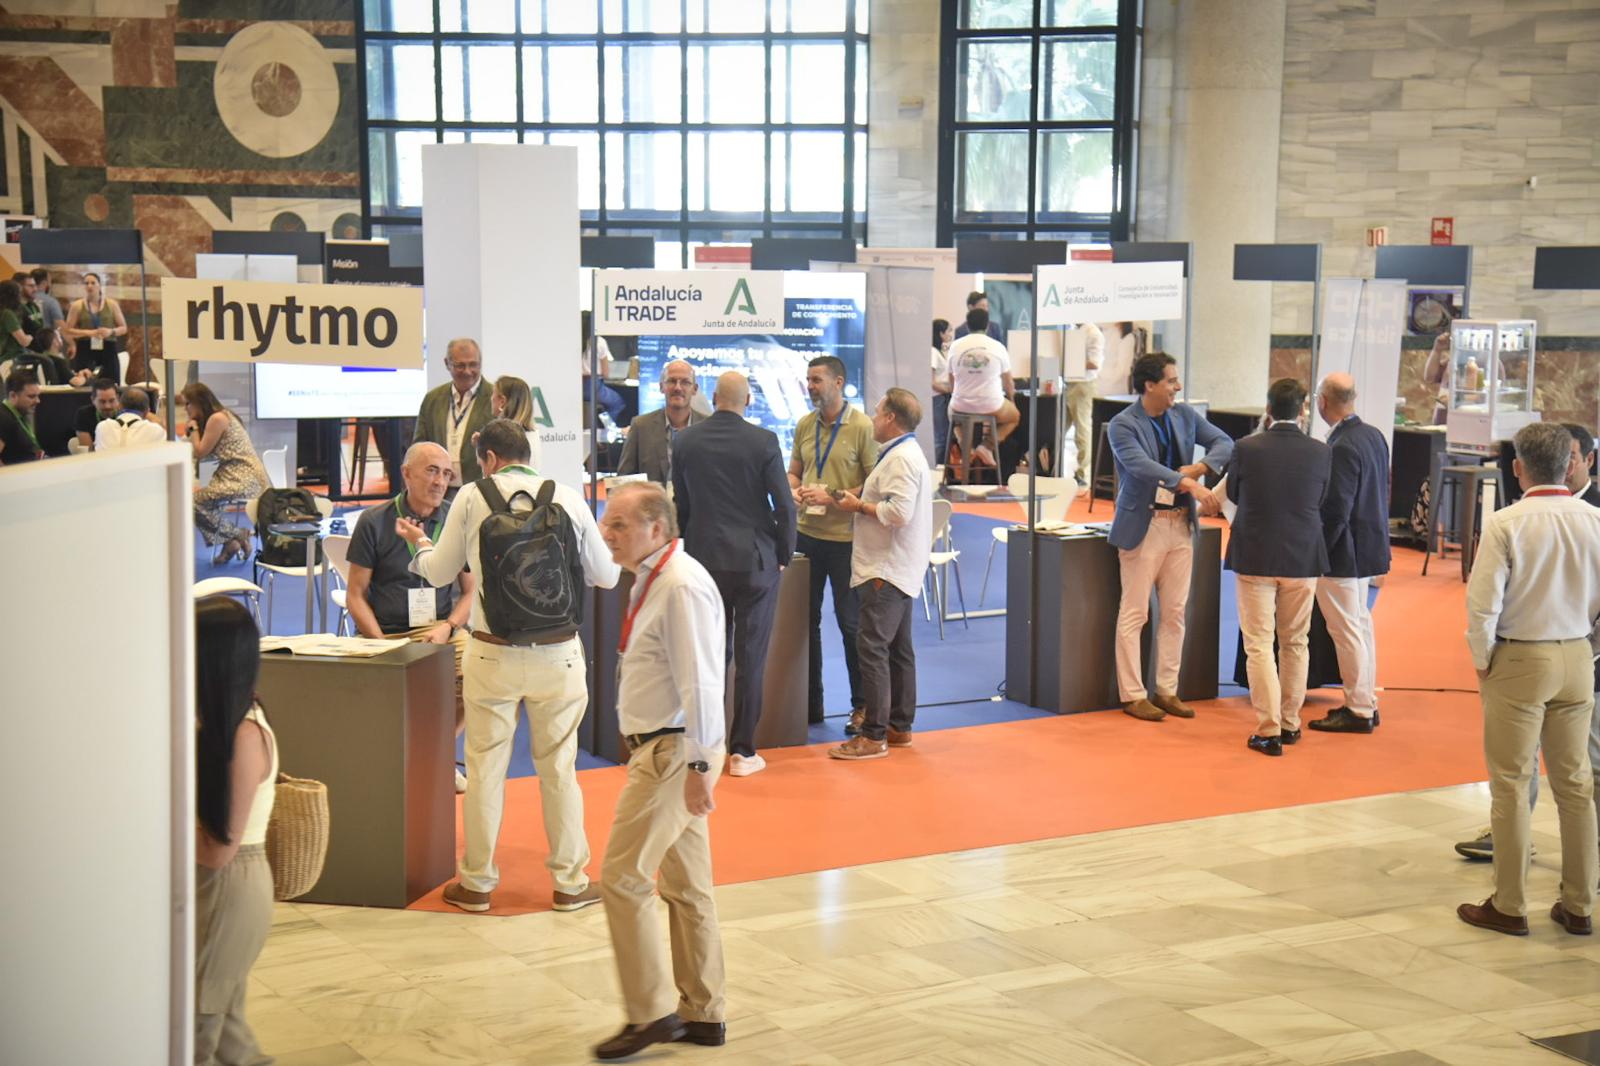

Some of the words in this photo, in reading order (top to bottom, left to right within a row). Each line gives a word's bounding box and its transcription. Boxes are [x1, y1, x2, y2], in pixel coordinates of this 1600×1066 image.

[615, 284, 702, 301] Andalucía
[1064, 286, 1084, 294] Junta
[1064, 296, 1073, 304] de
[1074, 294, 1109, 304] Andalucía
[615, 306, 677, 321] TRADE
[186, 286, 398, 357] rhytmo
[702, 319, 725, 328] Junta
[726, 319, 737, 328] de
[737, 318, 776, 328] Andalucía
[667, 345, 745, 360] Apoyamos
[748, 347, 766, 360] tu
[539, 430, 576, 441] ndalucía
